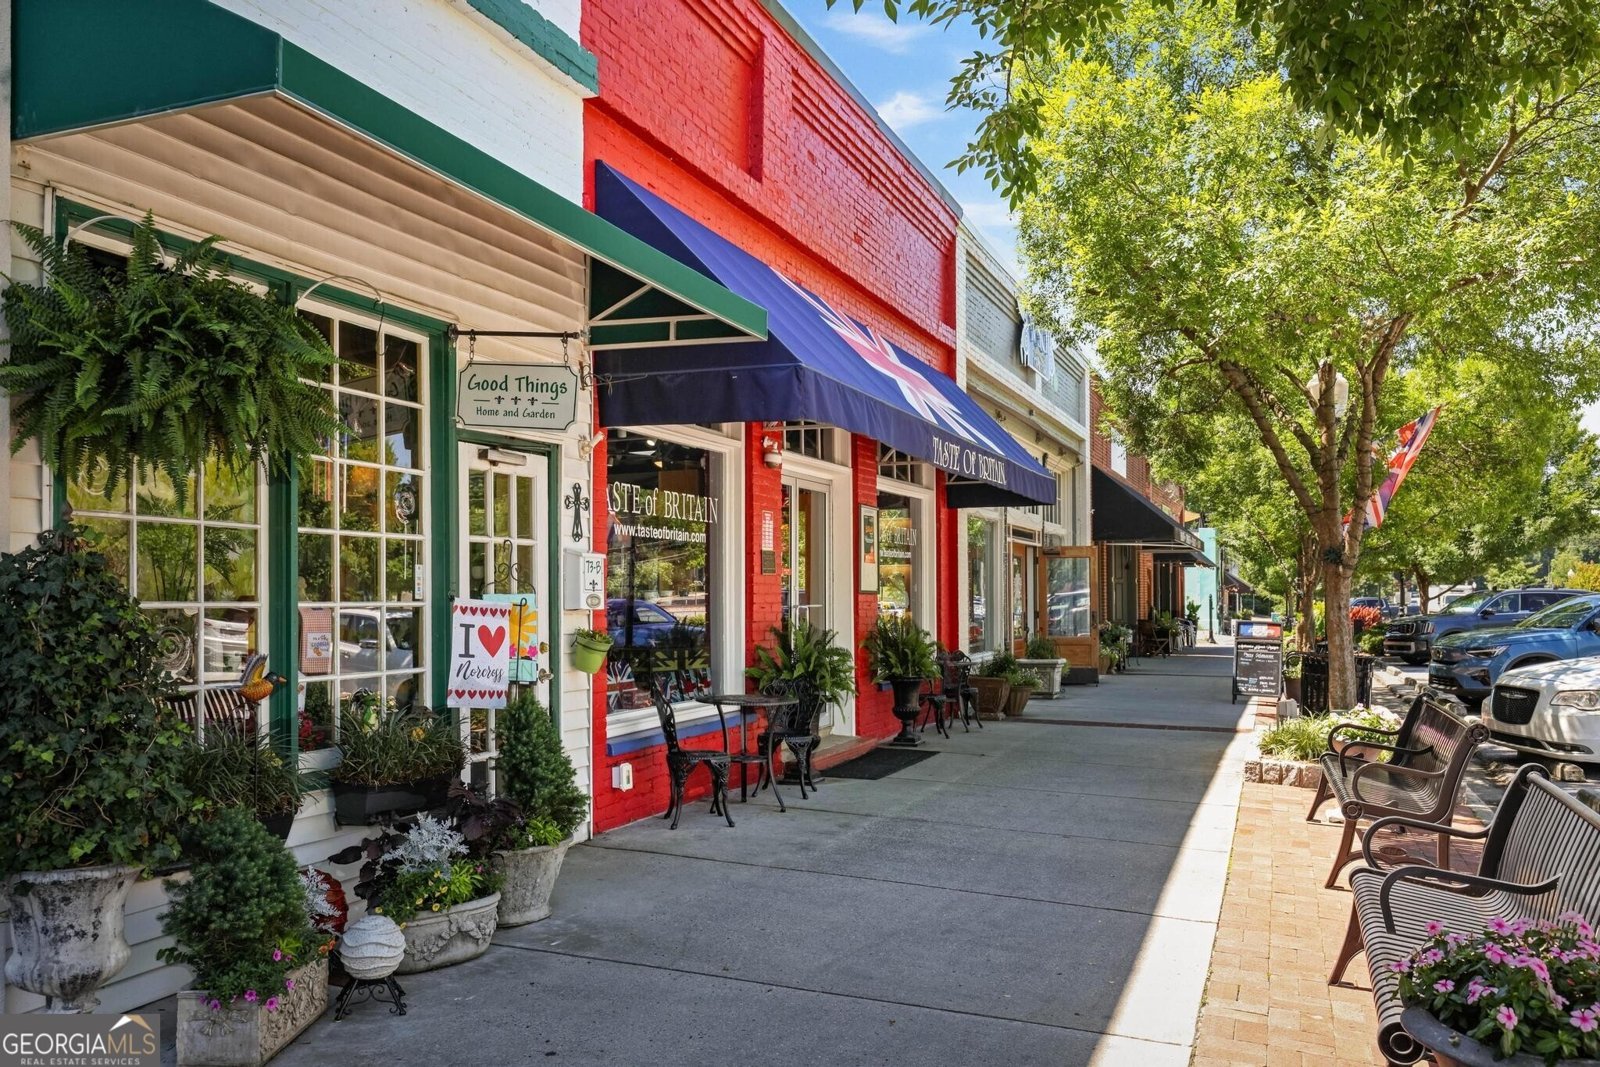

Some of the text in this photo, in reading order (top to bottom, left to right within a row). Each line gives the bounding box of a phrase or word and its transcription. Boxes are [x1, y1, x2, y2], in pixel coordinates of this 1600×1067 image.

[467, 373, 568, 401] Good Things
[476, 406, 556, 419] Home and Garden
[932, 435, 1007, 485] TASTE OF BRITAIN
[645, 487, 659, 516] of
[663, 490, 719, 524] BRITAIN
[614, 523, 706, 543] www.tasteofbritain.com
[458, 623, 475, 658] I
[456, 660, 505, 683] Norcross
